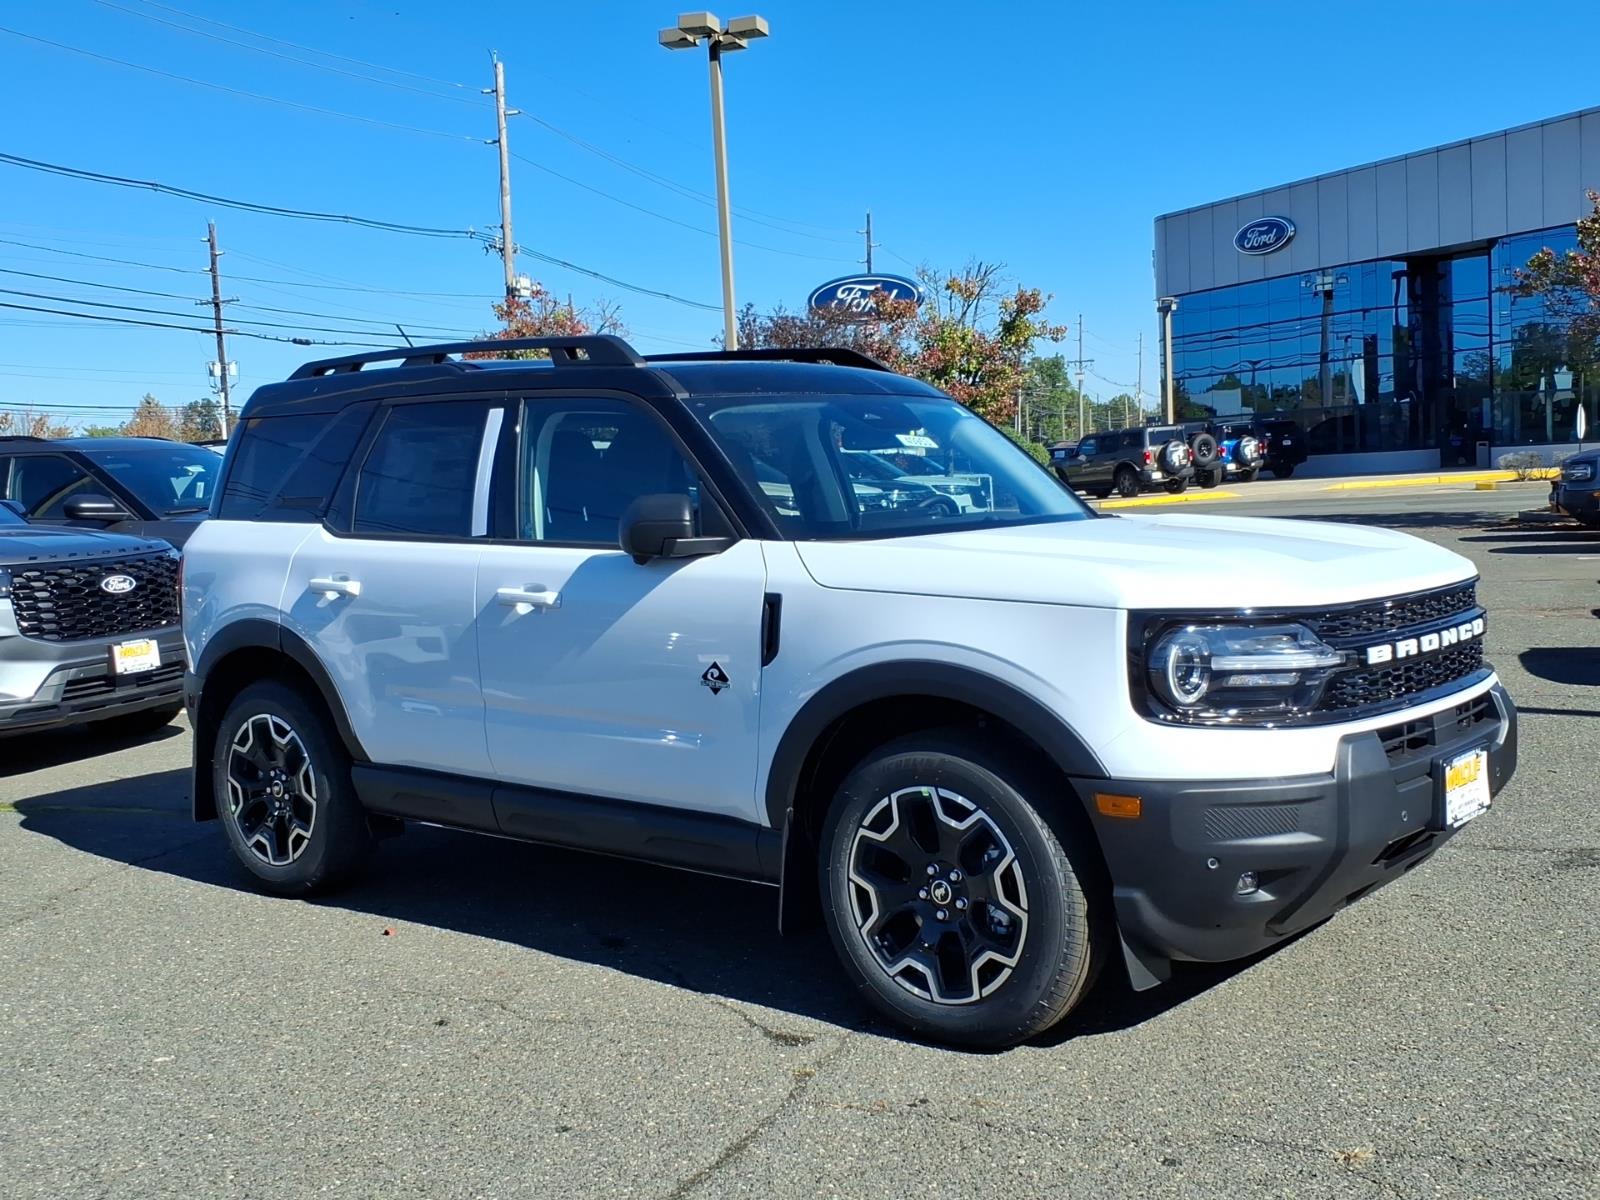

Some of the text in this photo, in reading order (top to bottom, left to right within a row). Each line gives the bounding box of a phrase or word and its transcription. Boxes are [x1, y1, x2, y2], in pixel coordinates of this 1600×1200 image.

[1244, 226, 1277, 248] Ford
[107, 577, 131, 590] Ford
[1366, 618, 1485, 665] BRONCO
